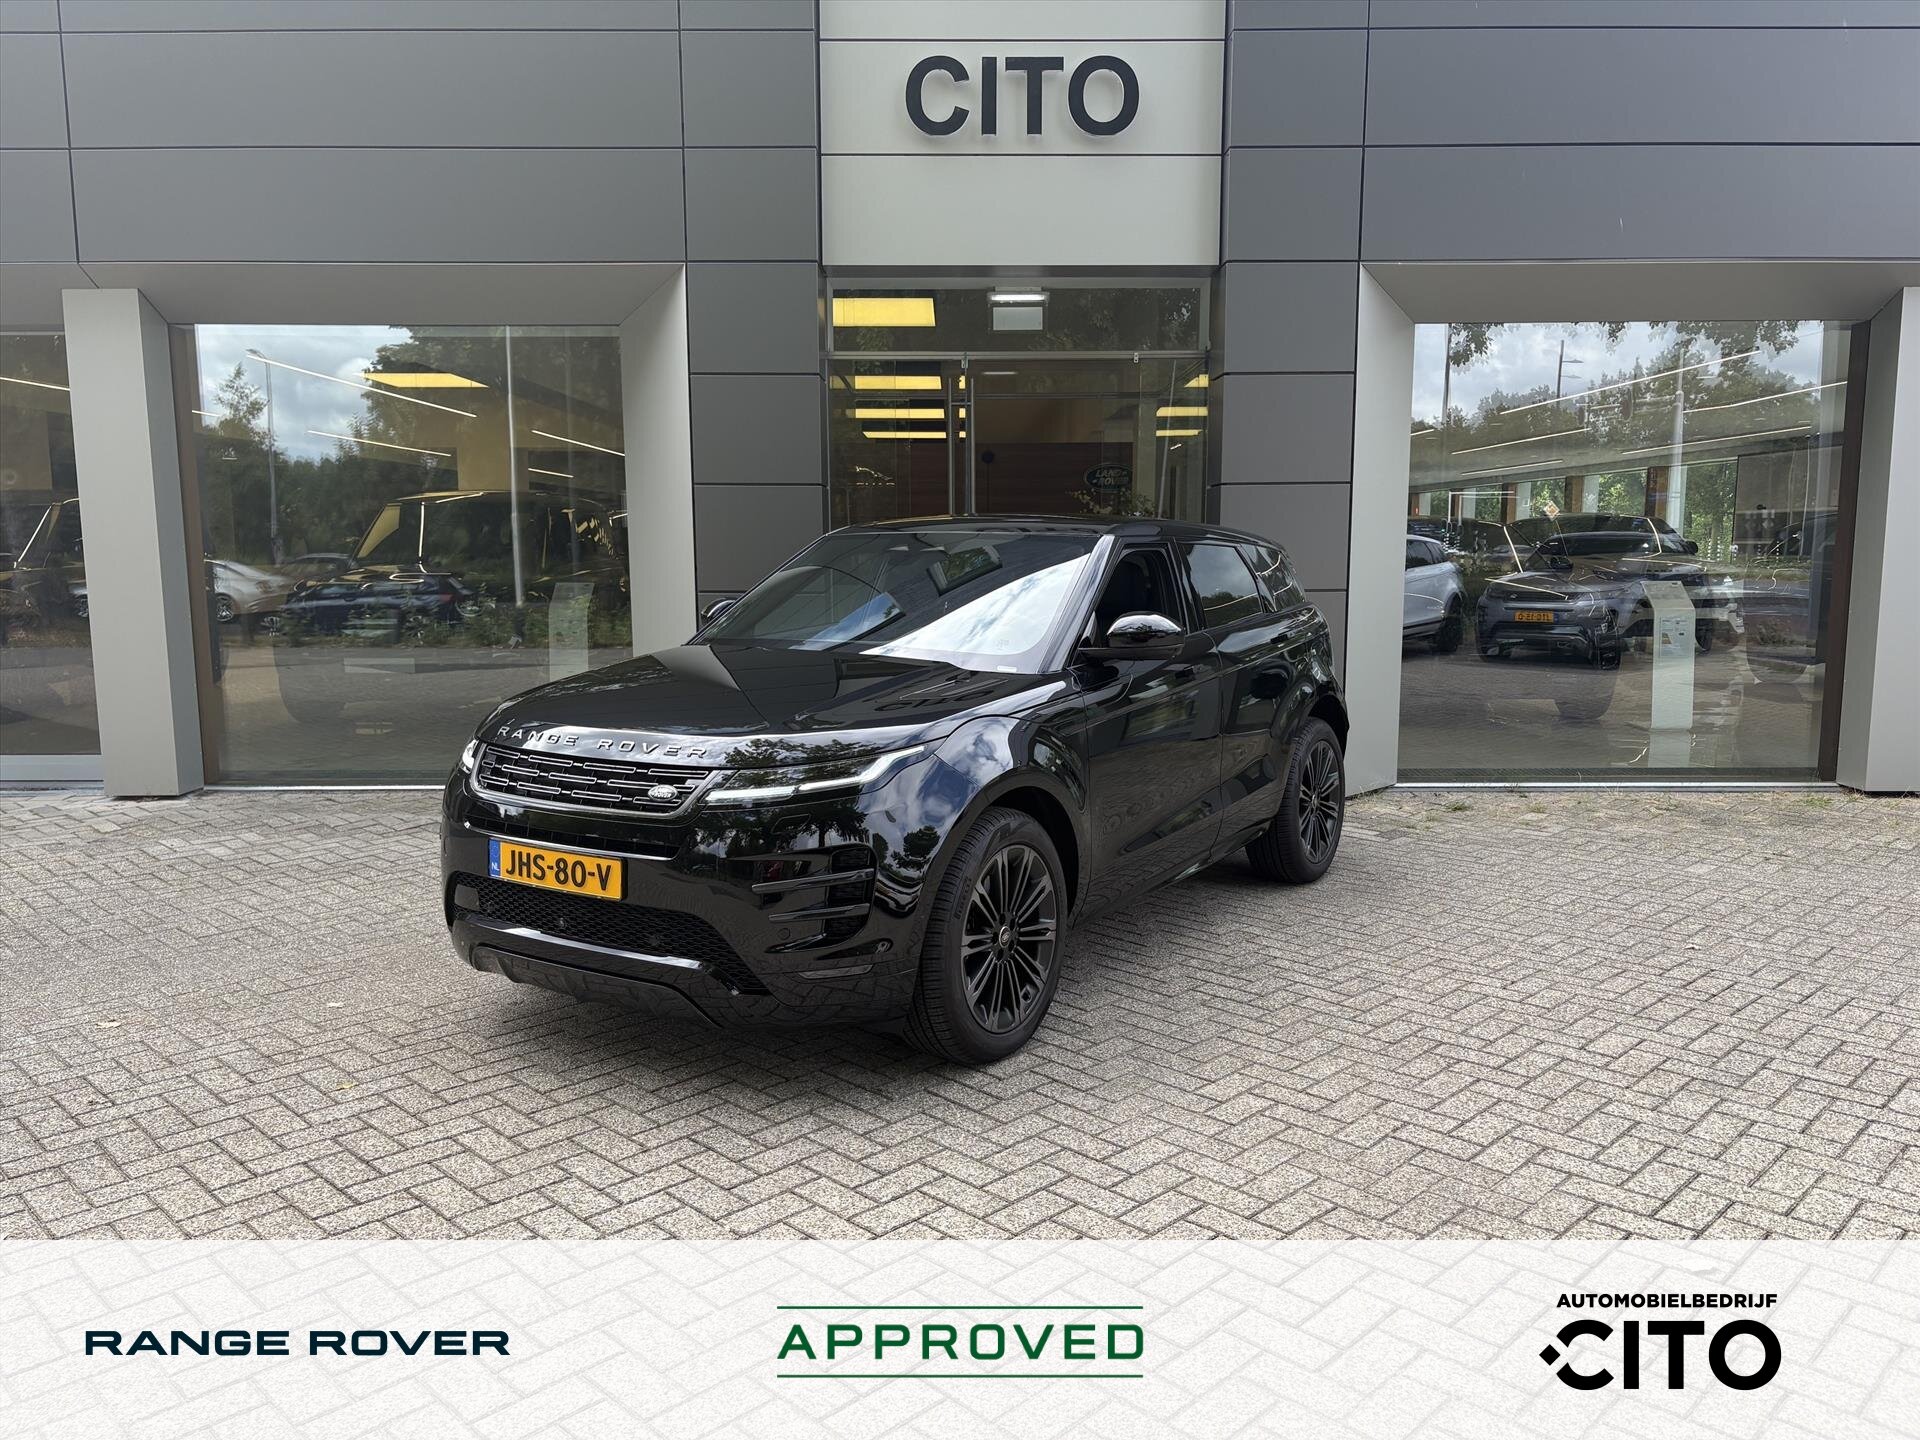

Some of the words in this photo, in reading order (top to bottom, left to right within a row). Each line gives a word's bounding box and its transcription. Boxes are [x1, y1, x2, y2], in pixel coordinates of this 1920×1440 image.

[905, 55, 1140, 136] CITO
[497, 725, 579, 747] RANGE
[596, 738, 708, 759] ROVER
[505, 849, 612, 891] JHS-80-V
